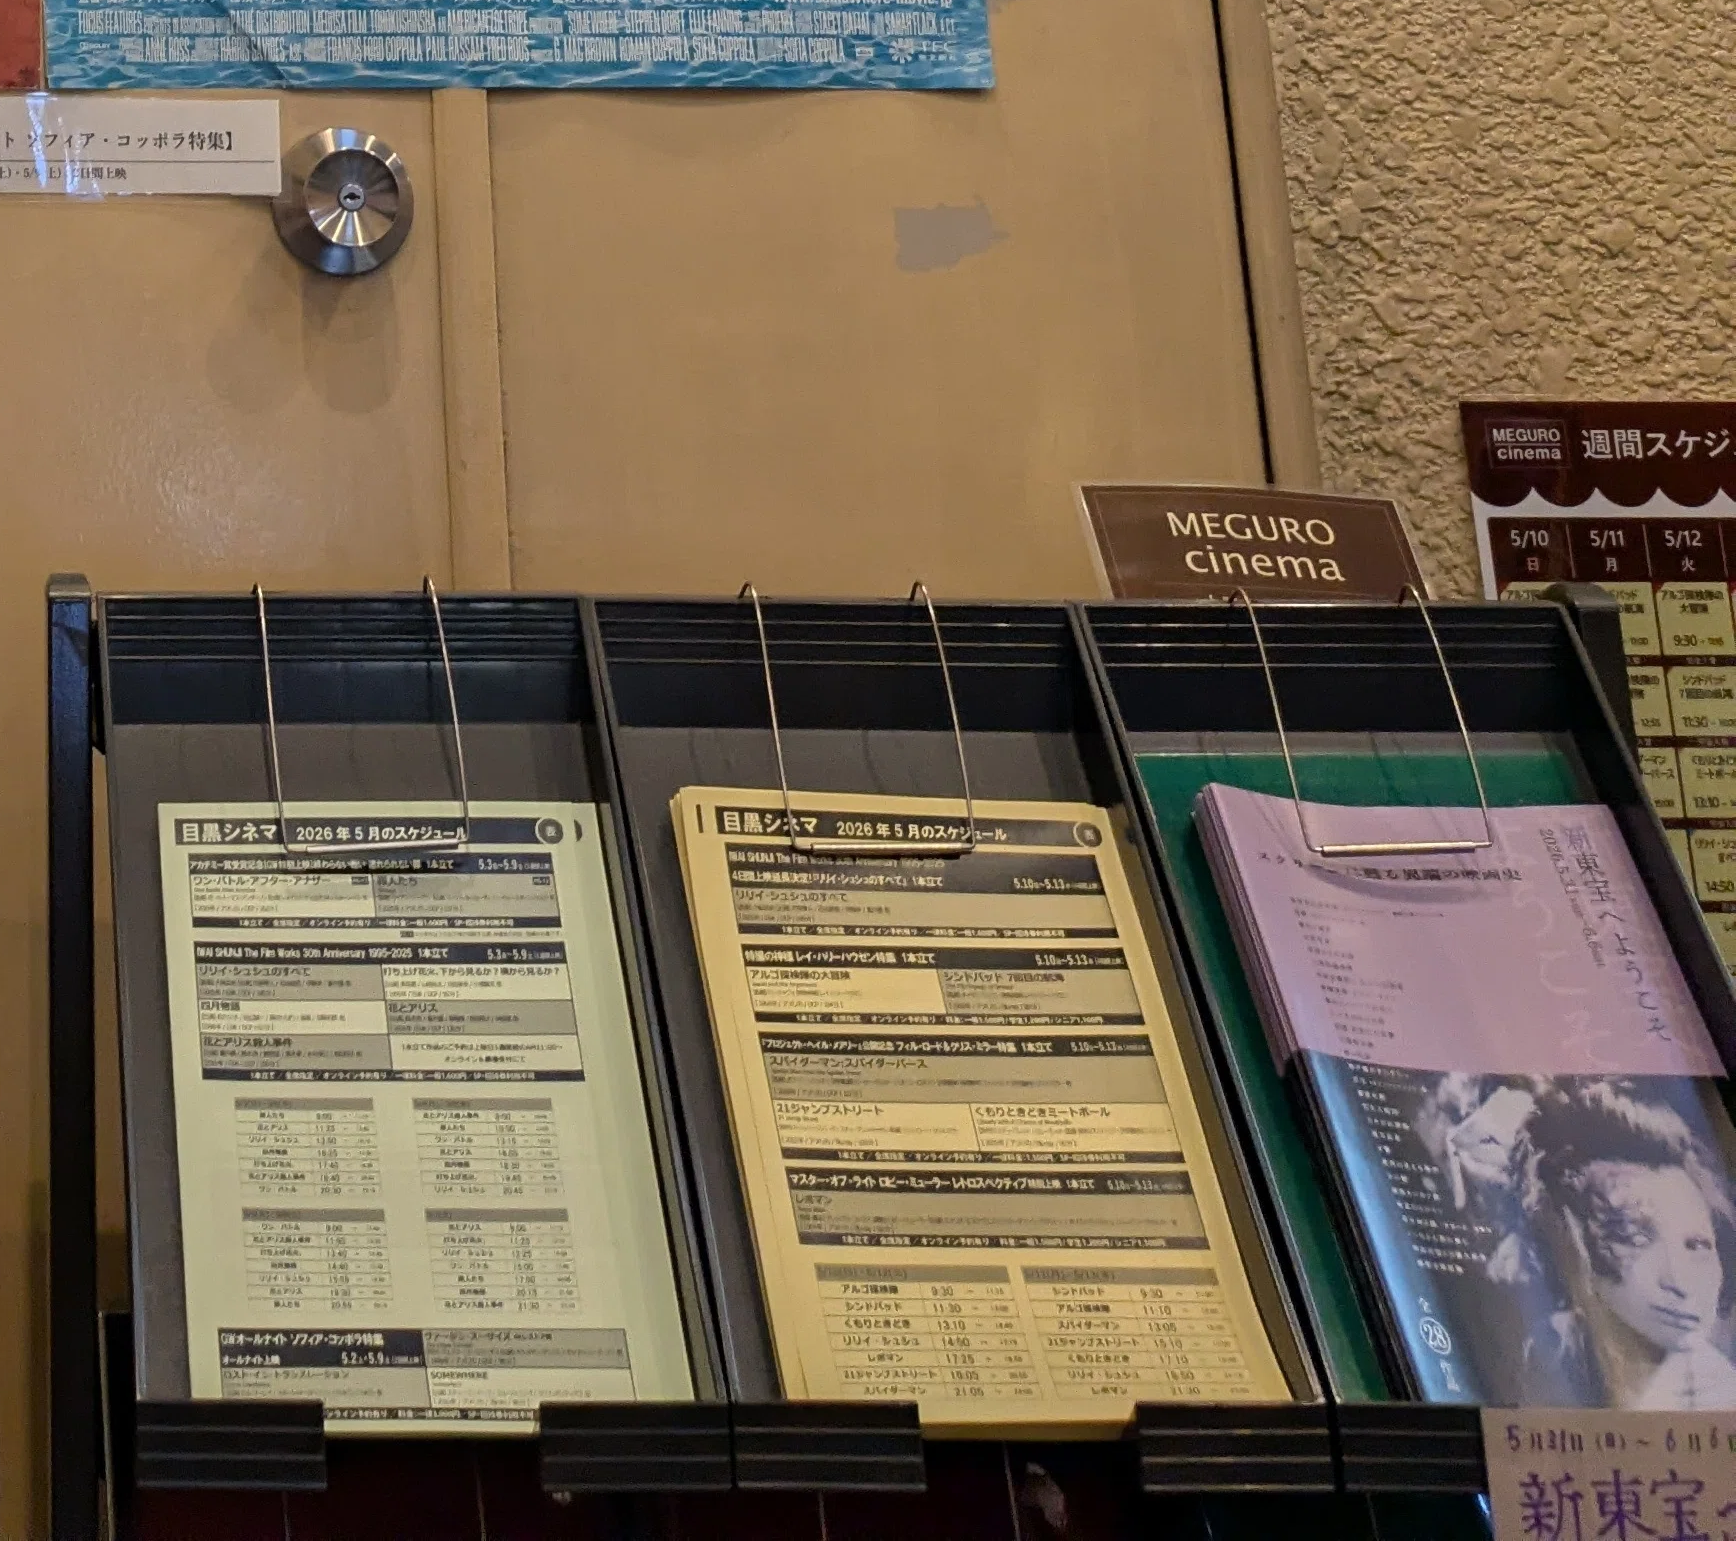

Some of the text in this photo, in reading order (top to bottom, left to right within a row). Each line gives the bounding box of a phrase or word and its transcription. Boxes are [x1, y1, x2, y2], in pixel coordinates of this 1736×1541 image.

[1491, 427, 1562, 443] MEGURO
[1496, 445, 1562, 461] cinema
[1164, 511, 1336, 547] MEGURO
[1509, 527, 1703, 551] 5/10 5/11 5/12
[1185, 546, 1347, 583] cinema
[1525, 556, 1697, 574] 日 月 火
[181, 822, 279, 844] 目黒シネマ
